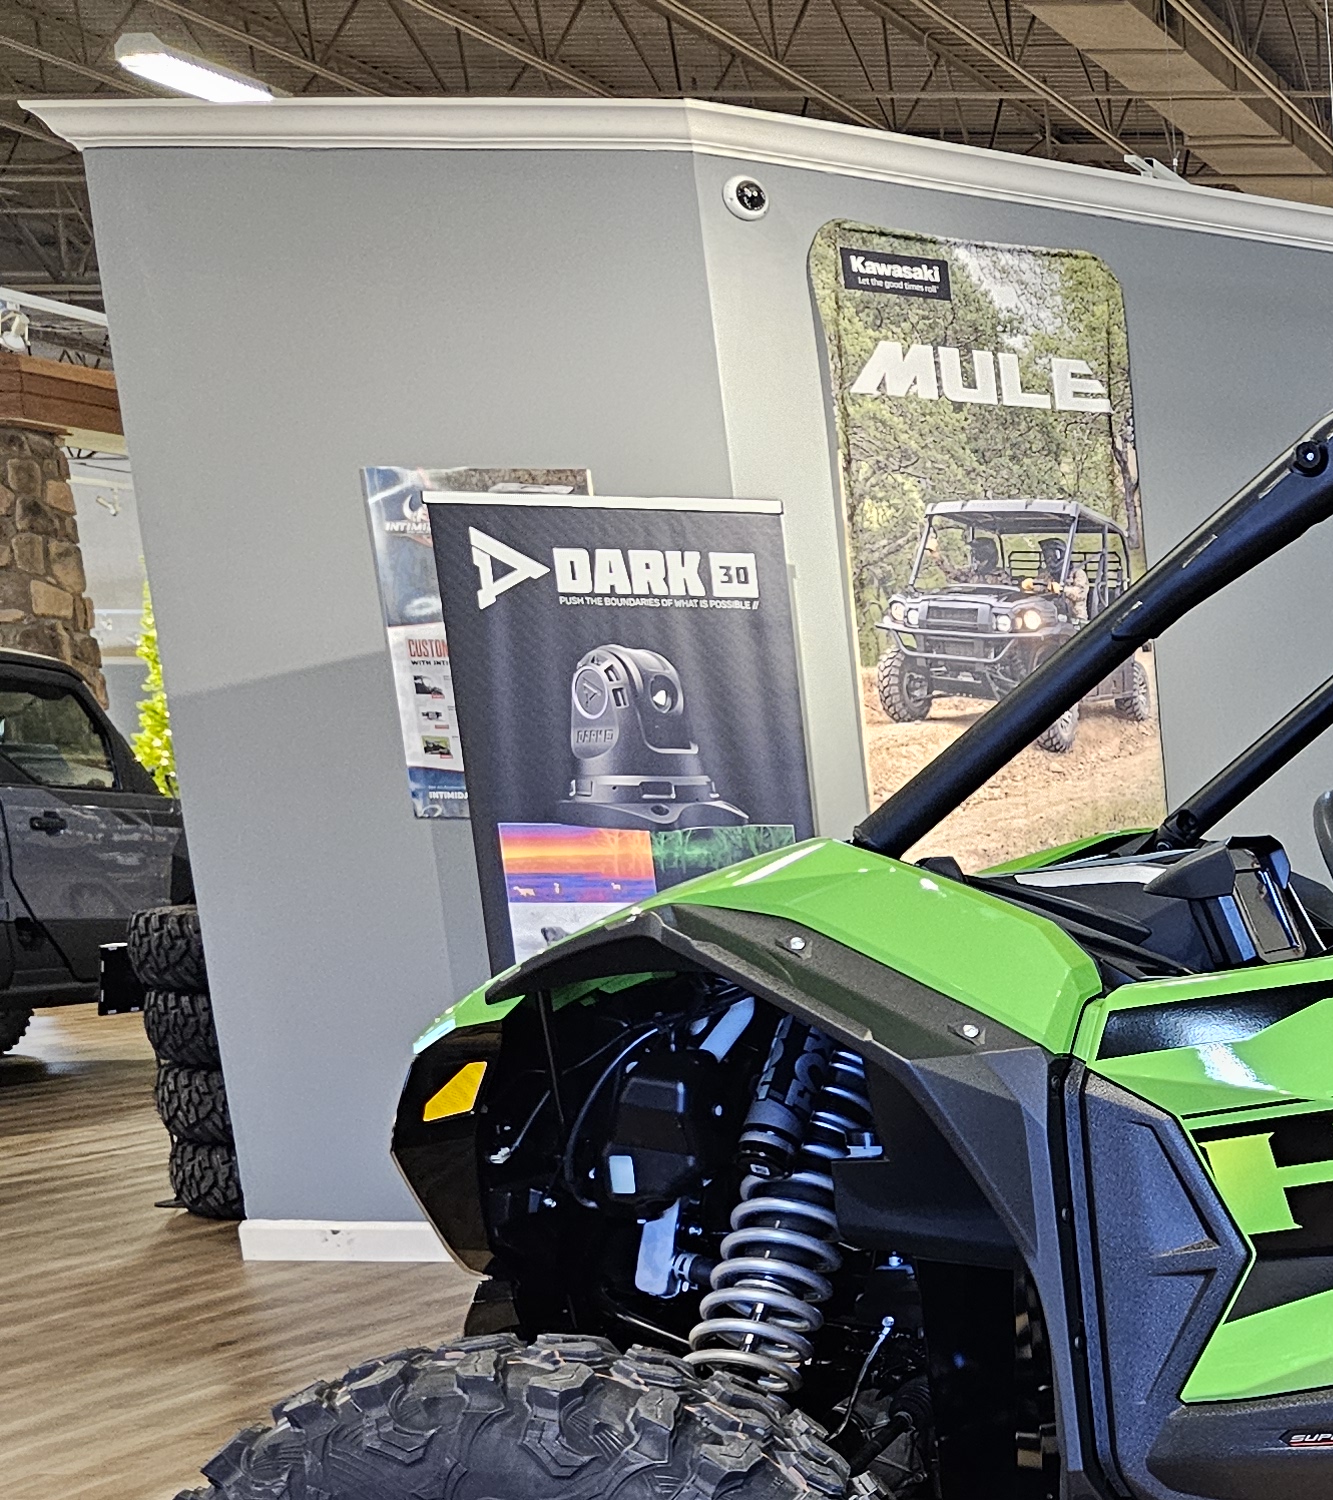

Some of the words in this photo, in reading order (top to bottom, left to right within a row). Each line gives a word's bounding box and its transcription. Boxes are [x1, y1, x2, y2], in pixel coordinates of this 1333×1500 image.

[849, 255, 940, 282] Kawasaki
[857, 276, 870, 285] Let
[870, 277, 883, 287] the
[884, 280, 903, 289] good
[904, 281, 924, 292] times
[850, 340, 1113, 413] MULE
[552, 547, 706, 596] DARK
[719, 565, 750, 584] 30
[559, 596, 584, 605] PUSH
[585, 597, 603, 606] THE
[604, 597, 660, 607] BOUNDARIES
[660, 598, 673, 607] OF
[674, 599, 699, 608] WHAT
[699, 600, 708, 608] IS
[709, 600, 751, 609] POSSIBLE
